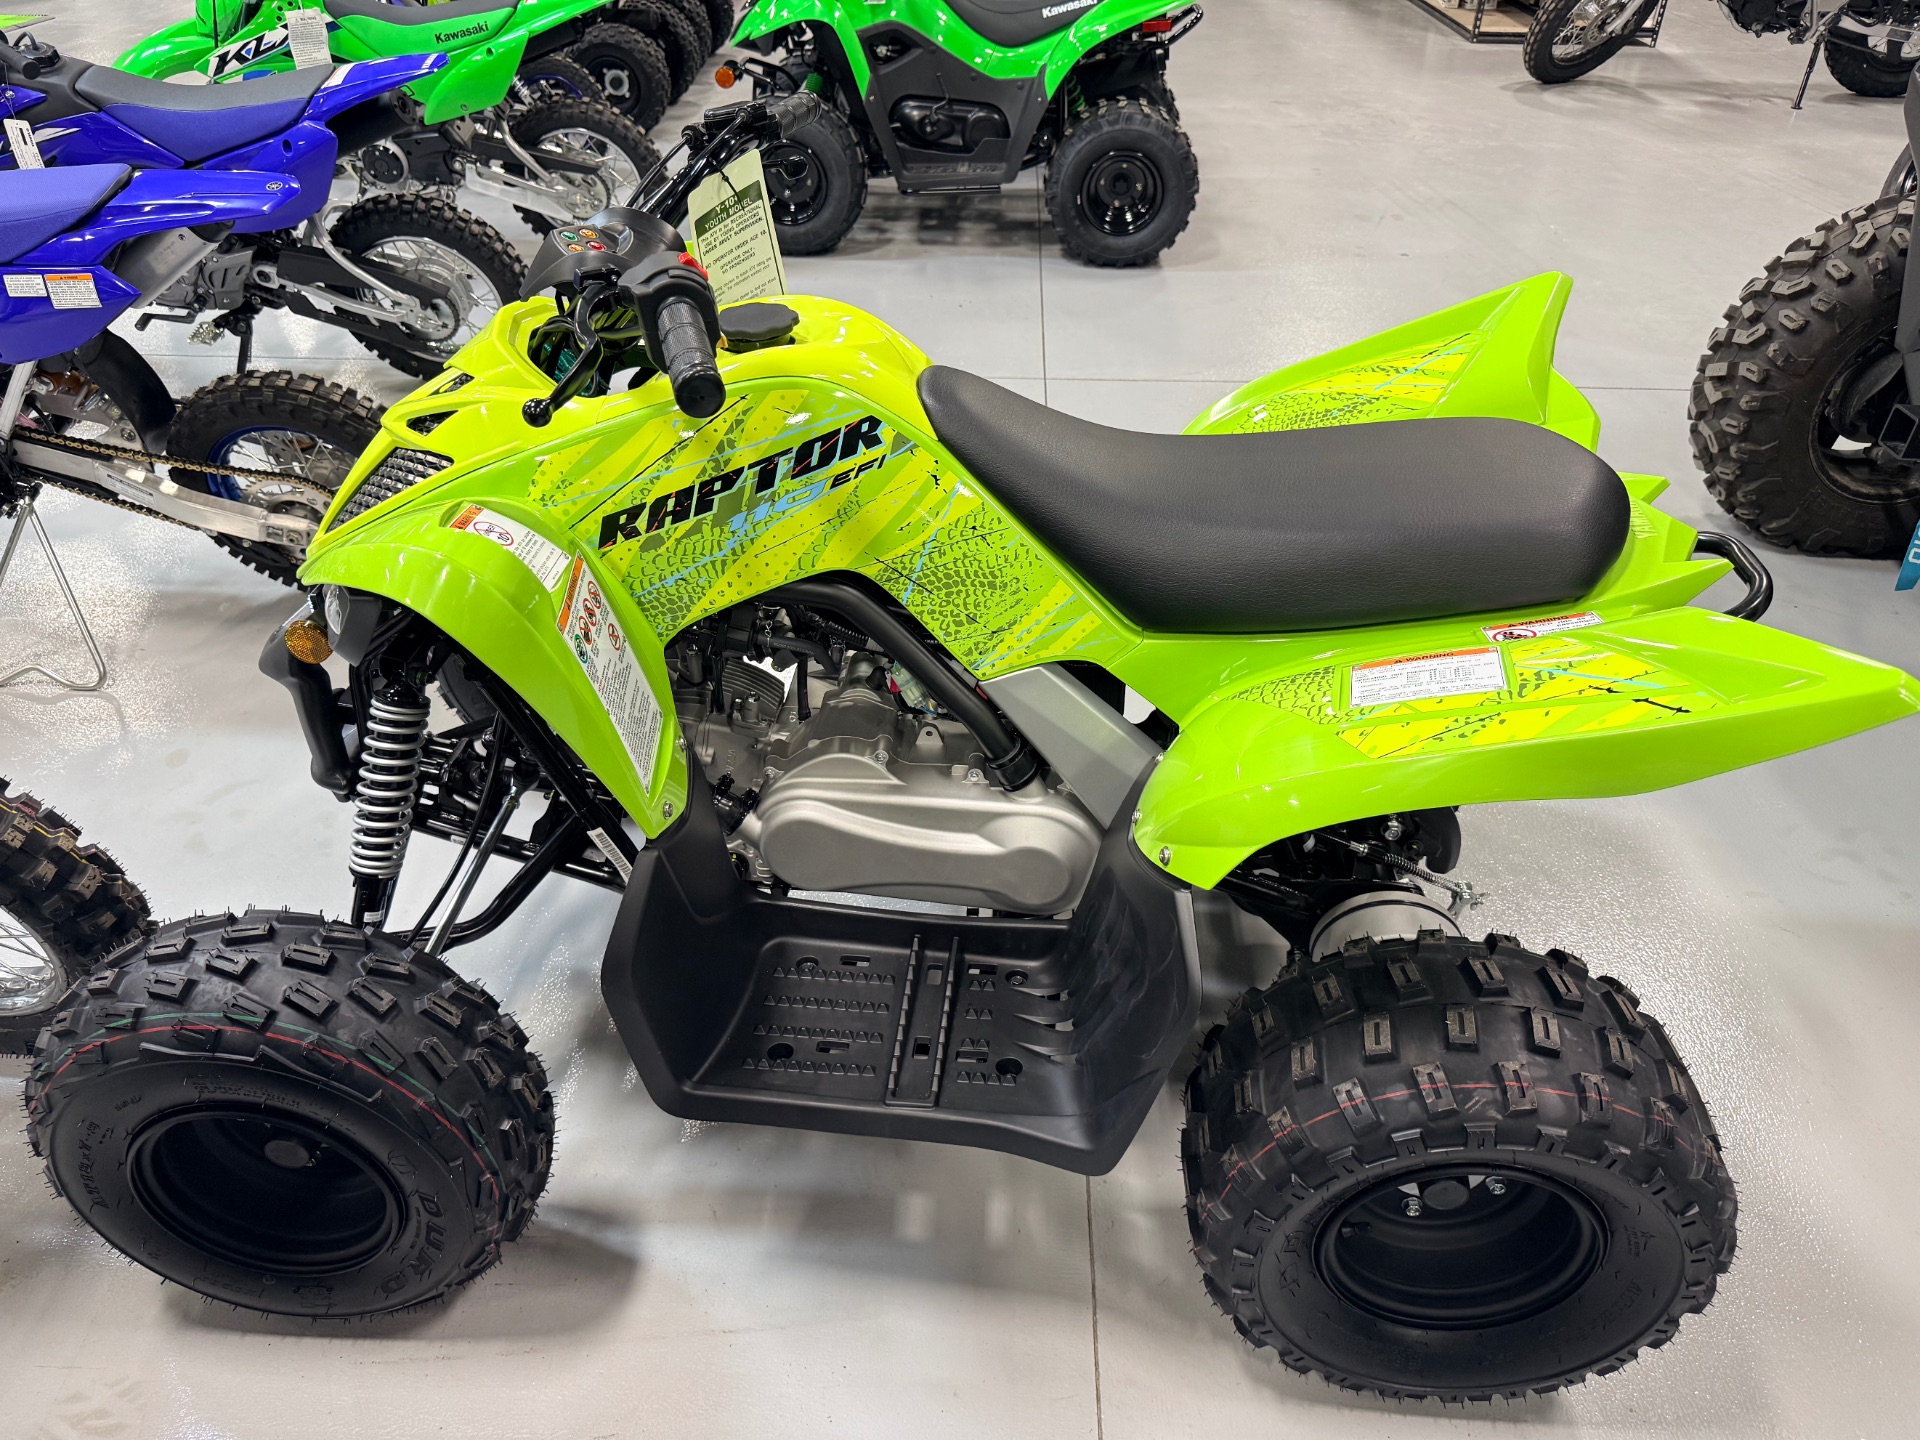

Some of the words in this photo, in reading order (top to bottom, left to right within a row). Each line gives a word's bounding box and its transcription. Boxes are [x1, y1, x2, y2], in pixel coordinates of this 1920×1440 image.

[1042, 0, 1098, 18] Kawasaki
[434, 20, 489, 44] Kawasaki
[705, 213, 727, 230] YOUTH
[598, 414, 884, 550] RAPTOR
[726, 474, 835, 532] 110
[829, 454, 887, 490] EFI
[1518, 616, 1569, 626] WARNING
[1406, 652, 1454, 661] WARNING
